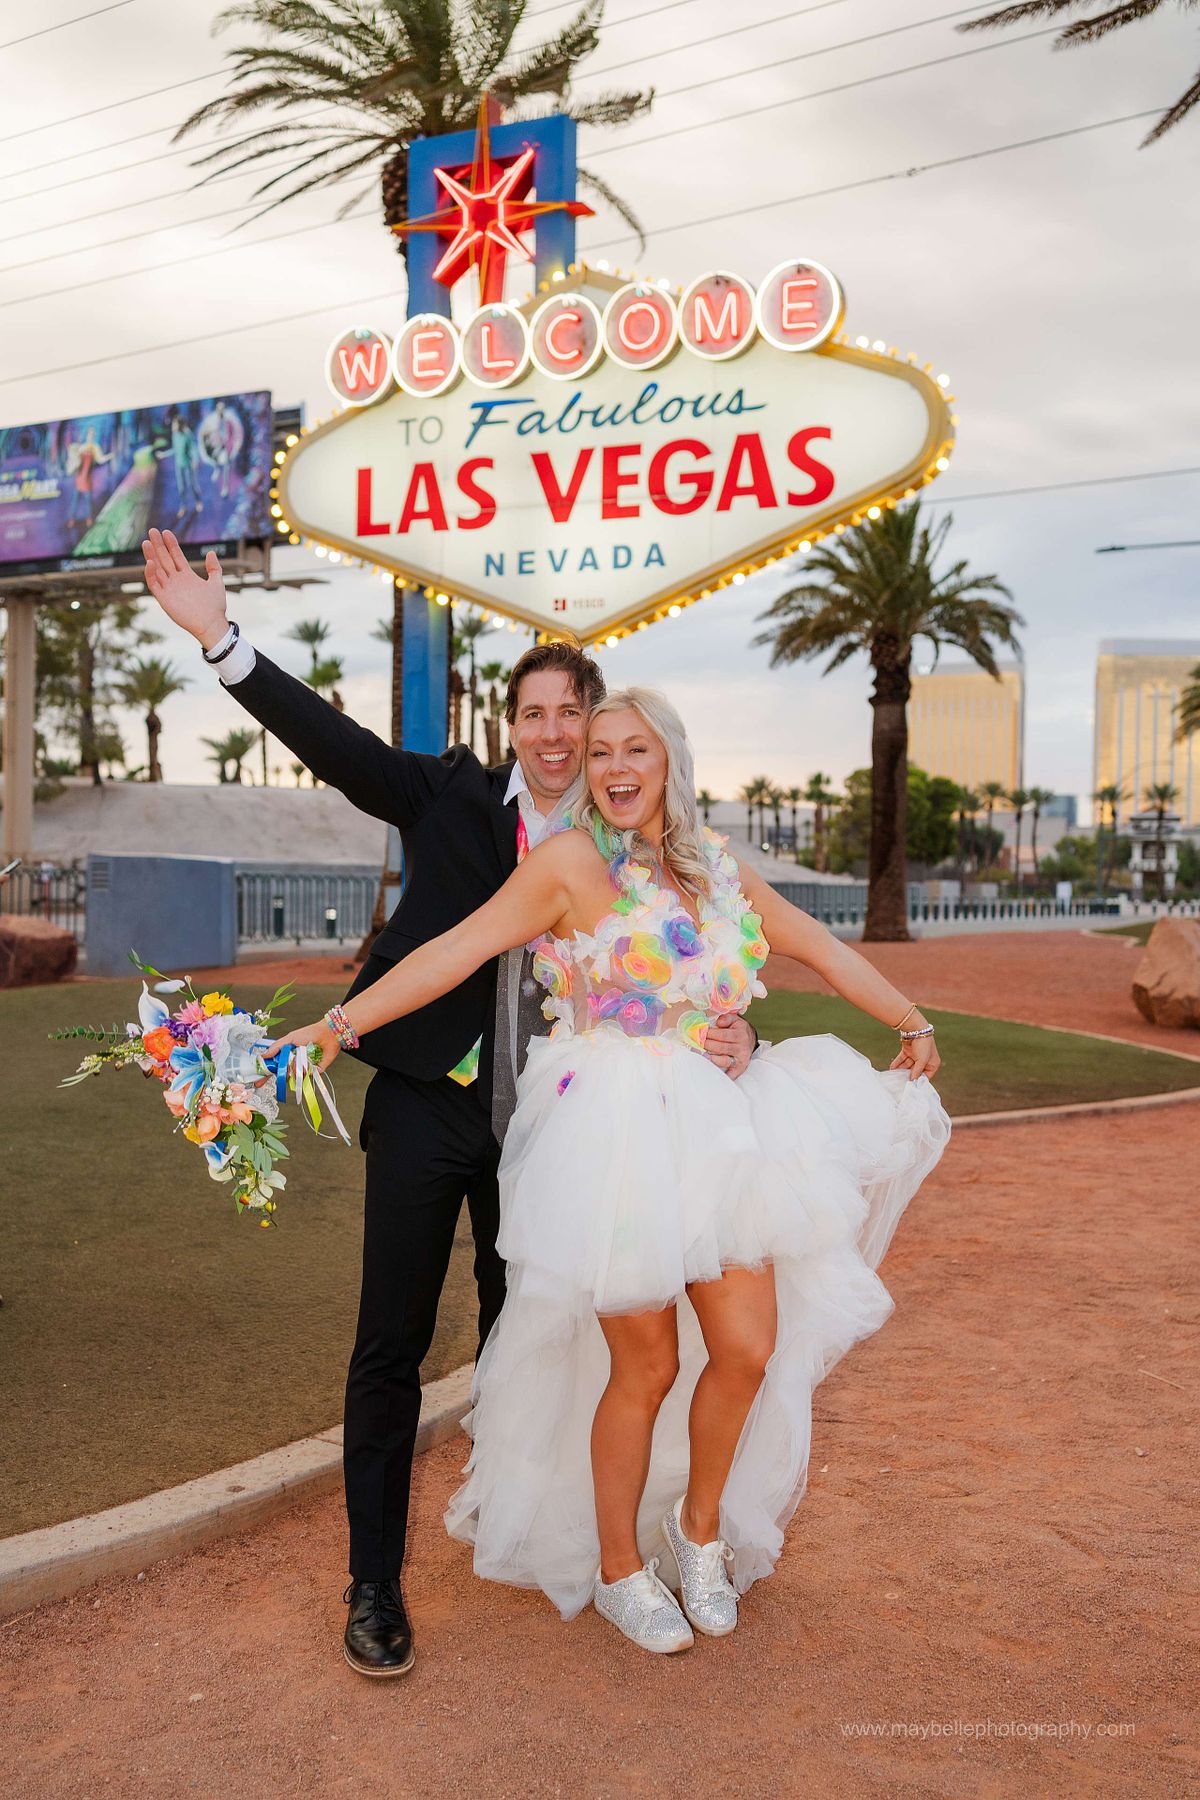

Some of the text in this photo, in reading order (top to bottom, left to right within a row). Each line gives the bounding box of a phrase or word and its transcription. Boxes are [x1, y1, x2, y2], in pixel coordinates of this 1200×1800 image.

[337, 276, 820, 394] WELCOME
[398, 382, 768, 449] TO Fabulous
[356, 426, 836, 537] LAS VEGAS
[484, 542, 666, 577] NEVADA
